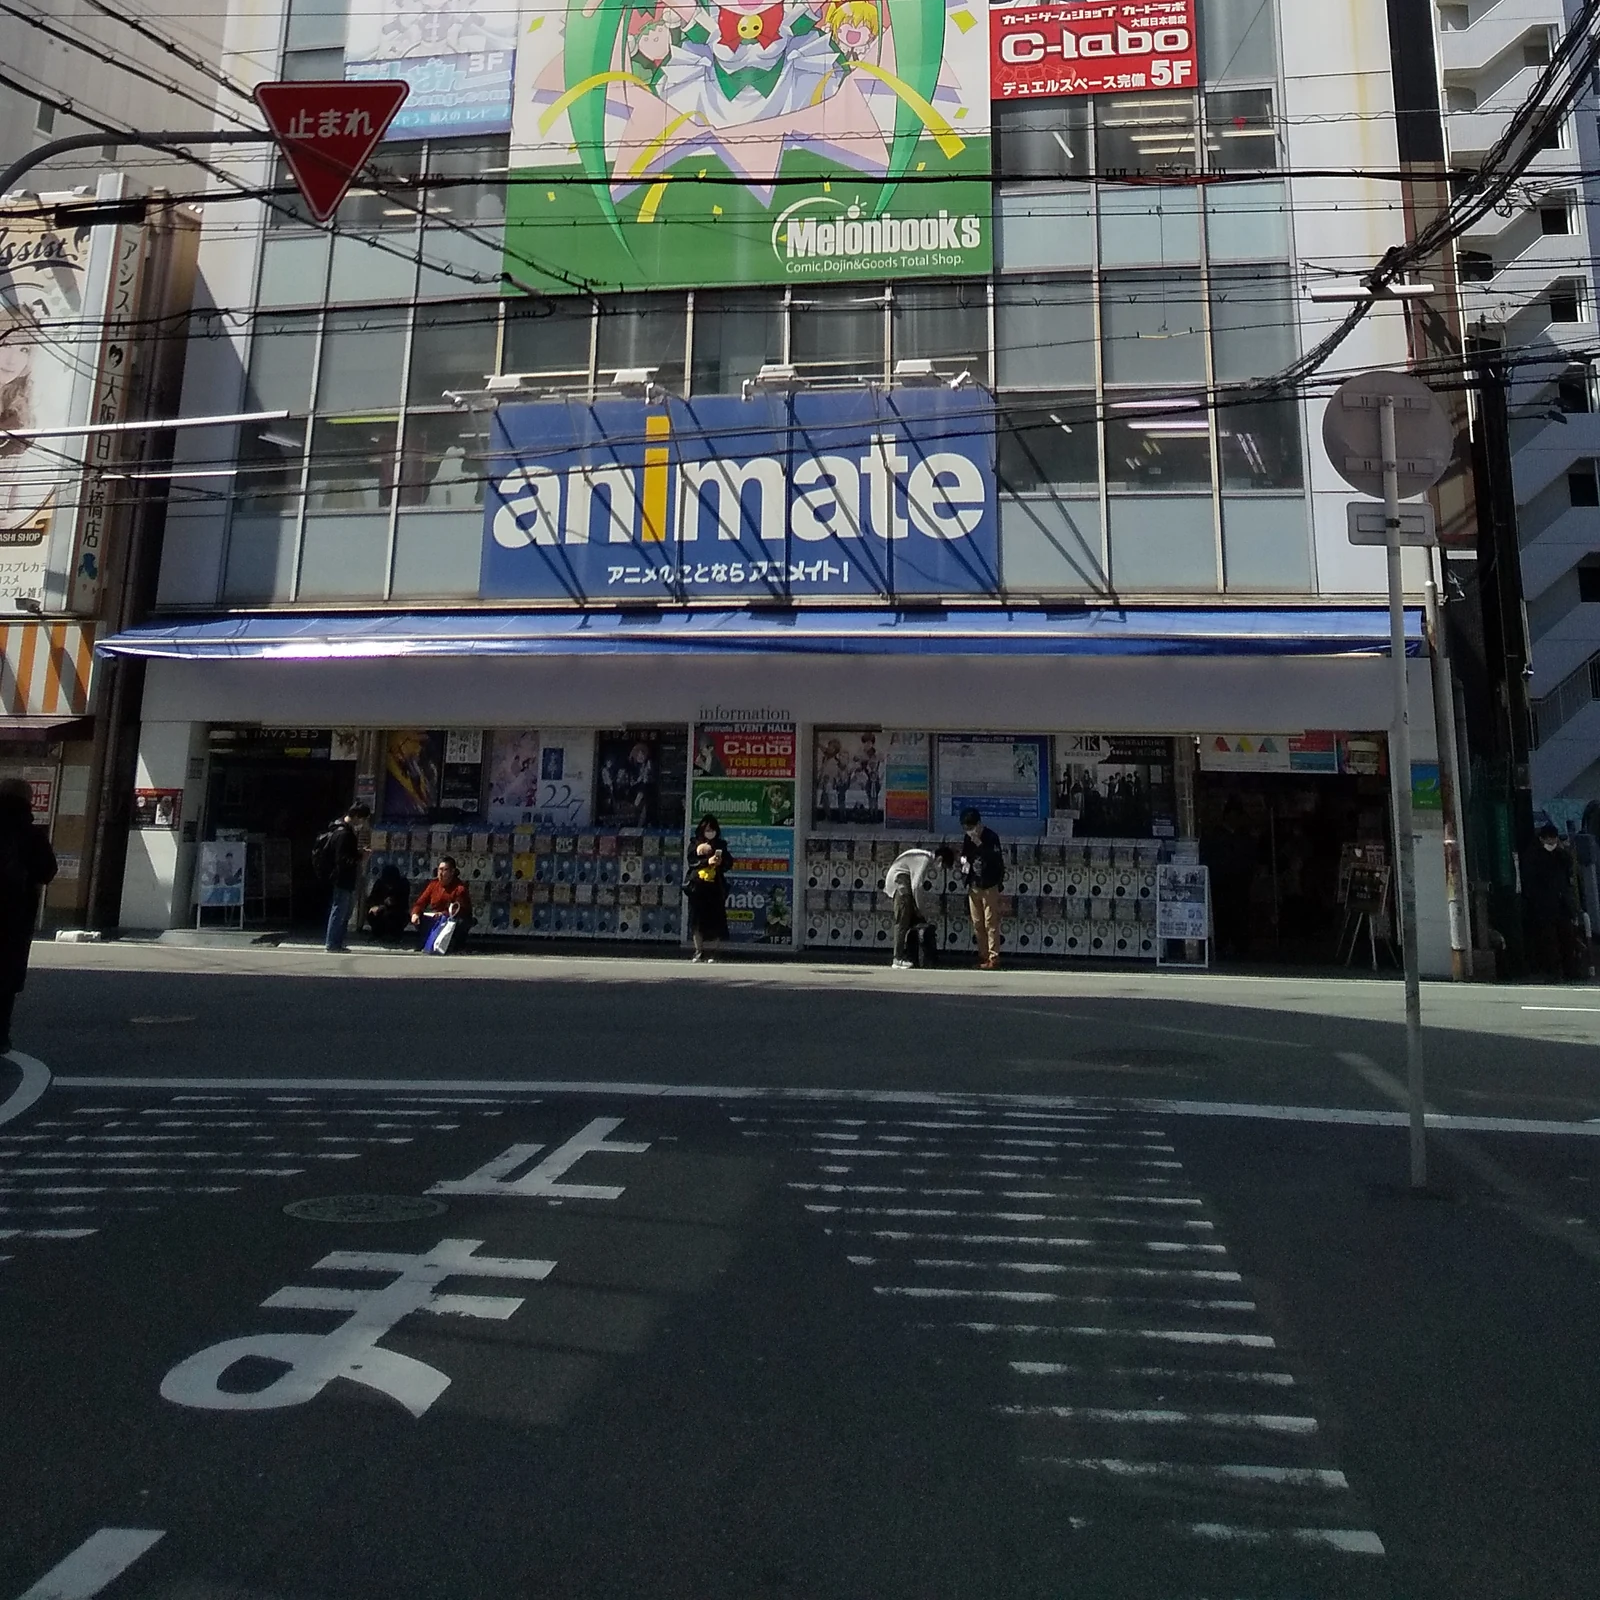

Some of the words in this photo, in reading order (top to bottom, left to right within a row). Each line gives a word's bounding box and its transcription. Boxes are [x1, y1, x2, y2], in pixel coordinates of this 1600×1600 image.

[1002, 7, 1117, 26] カードゲームショップ
[1122, 0, 1187, 16] カードラボ
[1001, 24, 1190, 64] C-labo
[468, 52, 505, 73] 3F
[1150, 59, 1192, 87] 5F
[1002, 72, 1147, 95] デュエルスペース完備
[284, 107, 374, 139] 止まれ
[786, 209, 981, 258] Melonbooks
[899, 255, 930, 267] Total
[492, 415, 986, 550] animate
[17, 532, 41, 542] SHOP
[698, 704, 791, 720] information
[734, 723, 765, 733] EVENT
[766, 723, 794, 733] HALL
[723, 740, 793, 756] C-labo
[698, 797, 758, 813] Melonbooks
